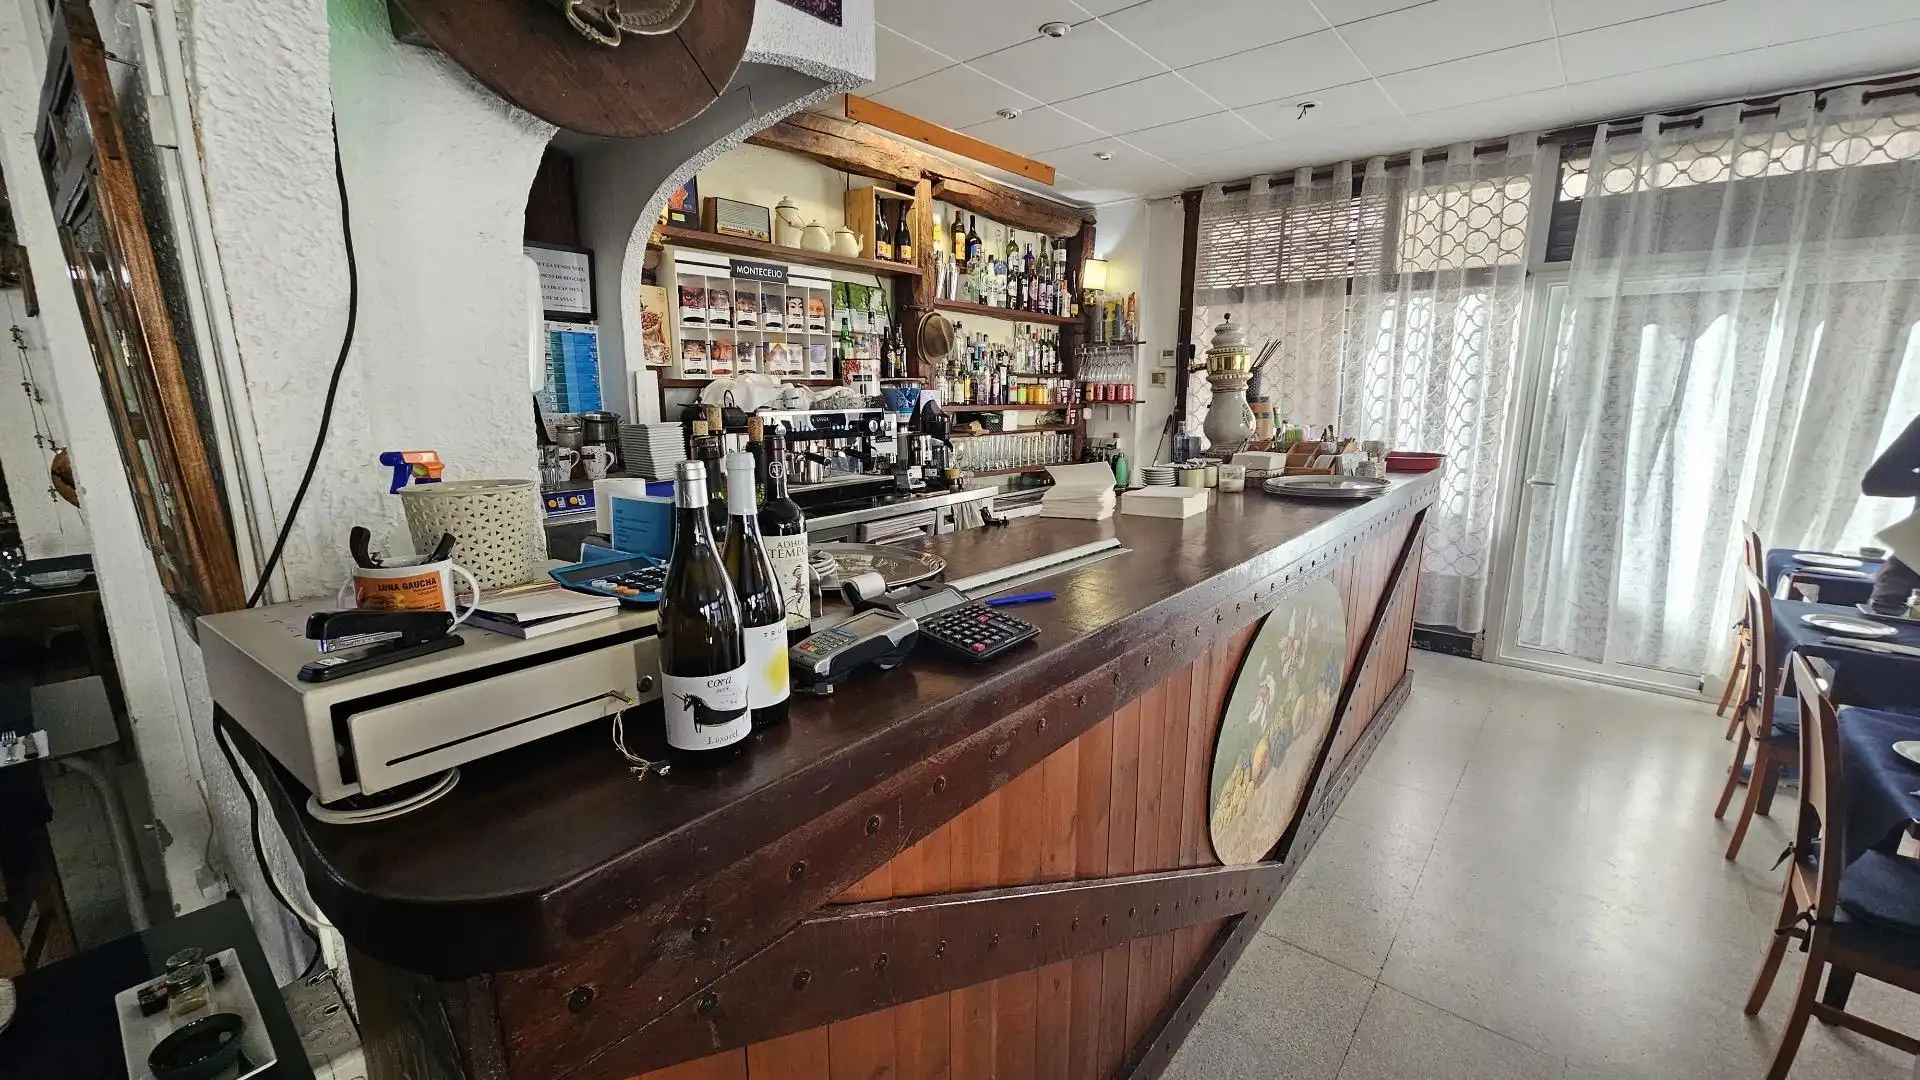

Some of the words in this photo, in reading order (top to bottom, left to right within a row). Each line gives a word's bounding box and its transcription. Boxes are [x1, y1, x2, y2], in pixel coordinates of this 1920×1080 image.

[736, 265, 783, 278] MONTECELIO
[378, 583, 400, 592] LUNA
[402, 578, 437, 590] GAUCHA
